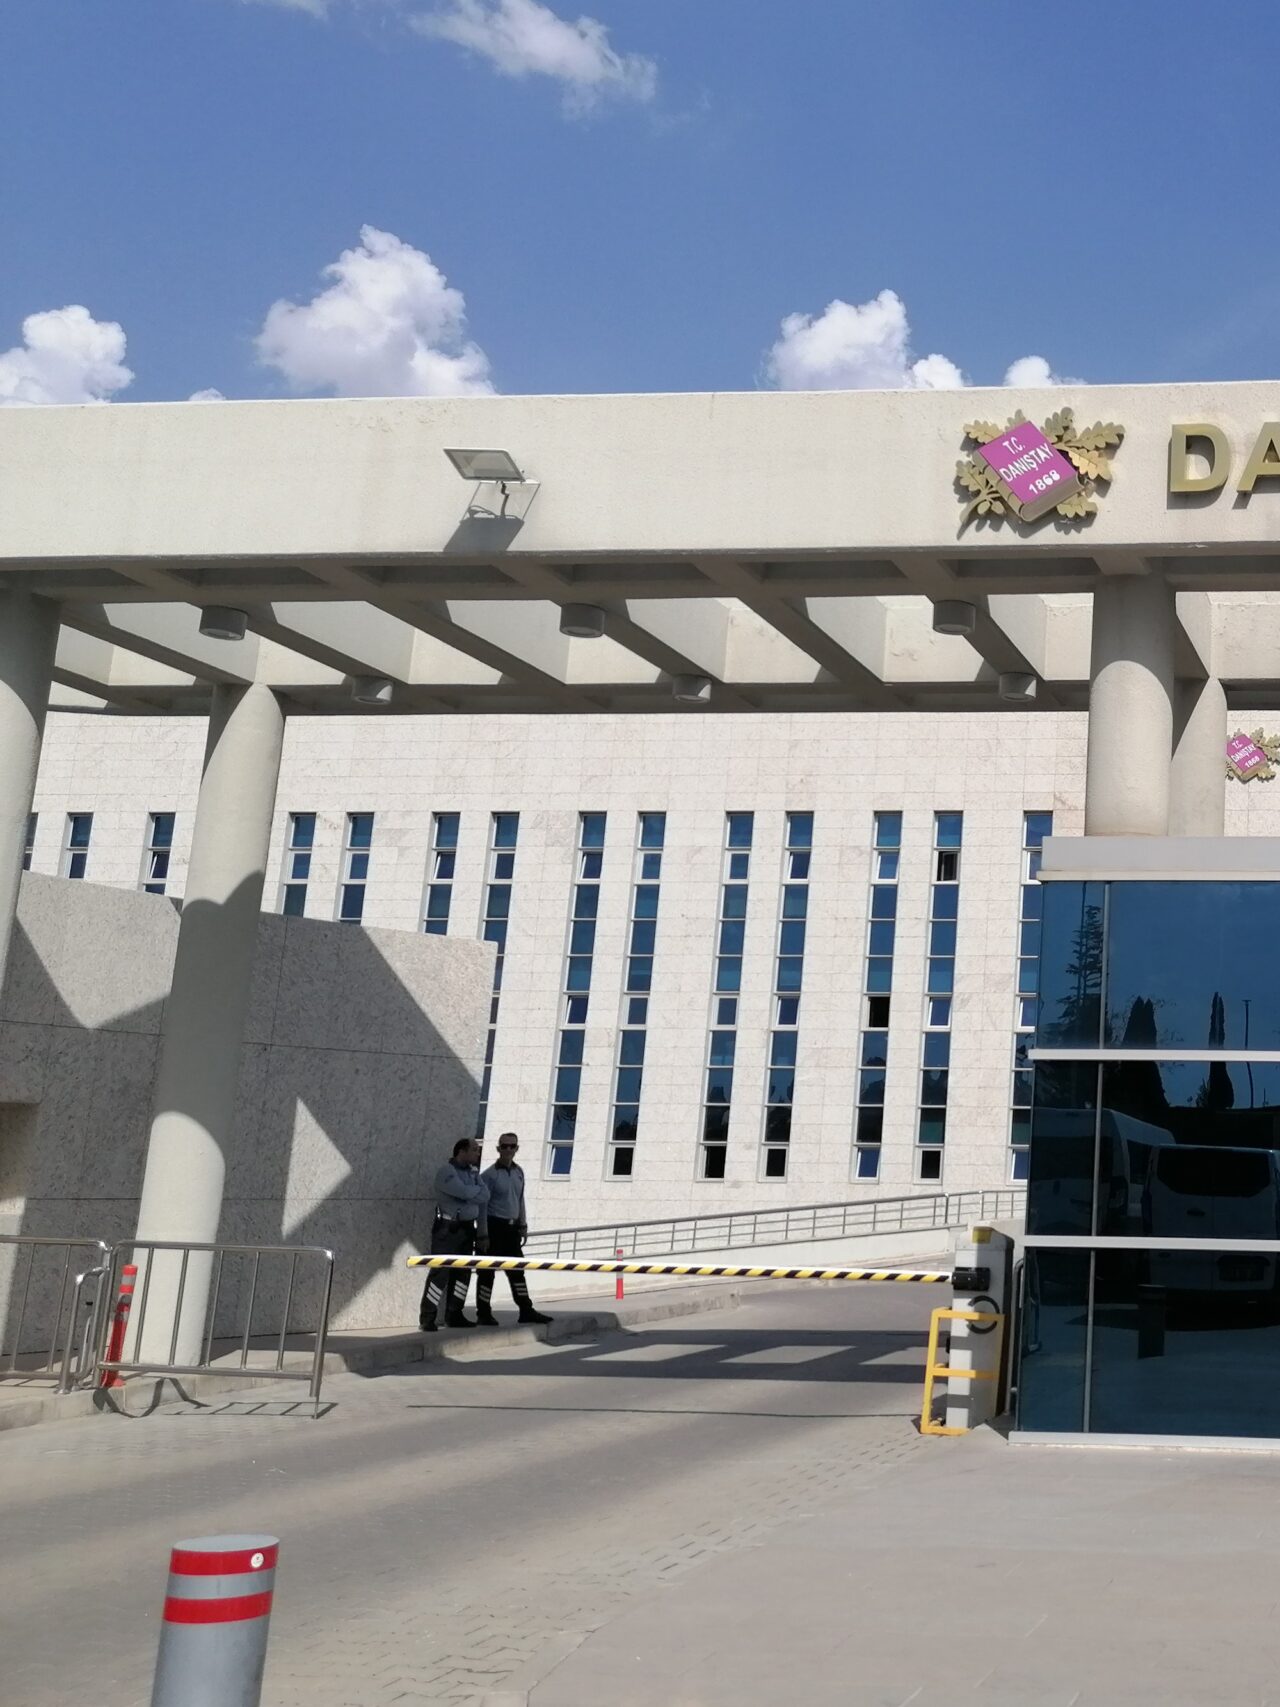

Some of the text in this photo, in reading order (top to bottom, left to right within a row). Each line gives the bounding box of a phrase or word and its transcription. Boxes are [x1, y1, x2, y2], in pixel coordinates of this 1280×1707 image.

[1002, 436, 1026, 455] T.C.
[999, 442, 1054, 482] DANIŞTAY
[1028, 469, 1061, 495] 1868
